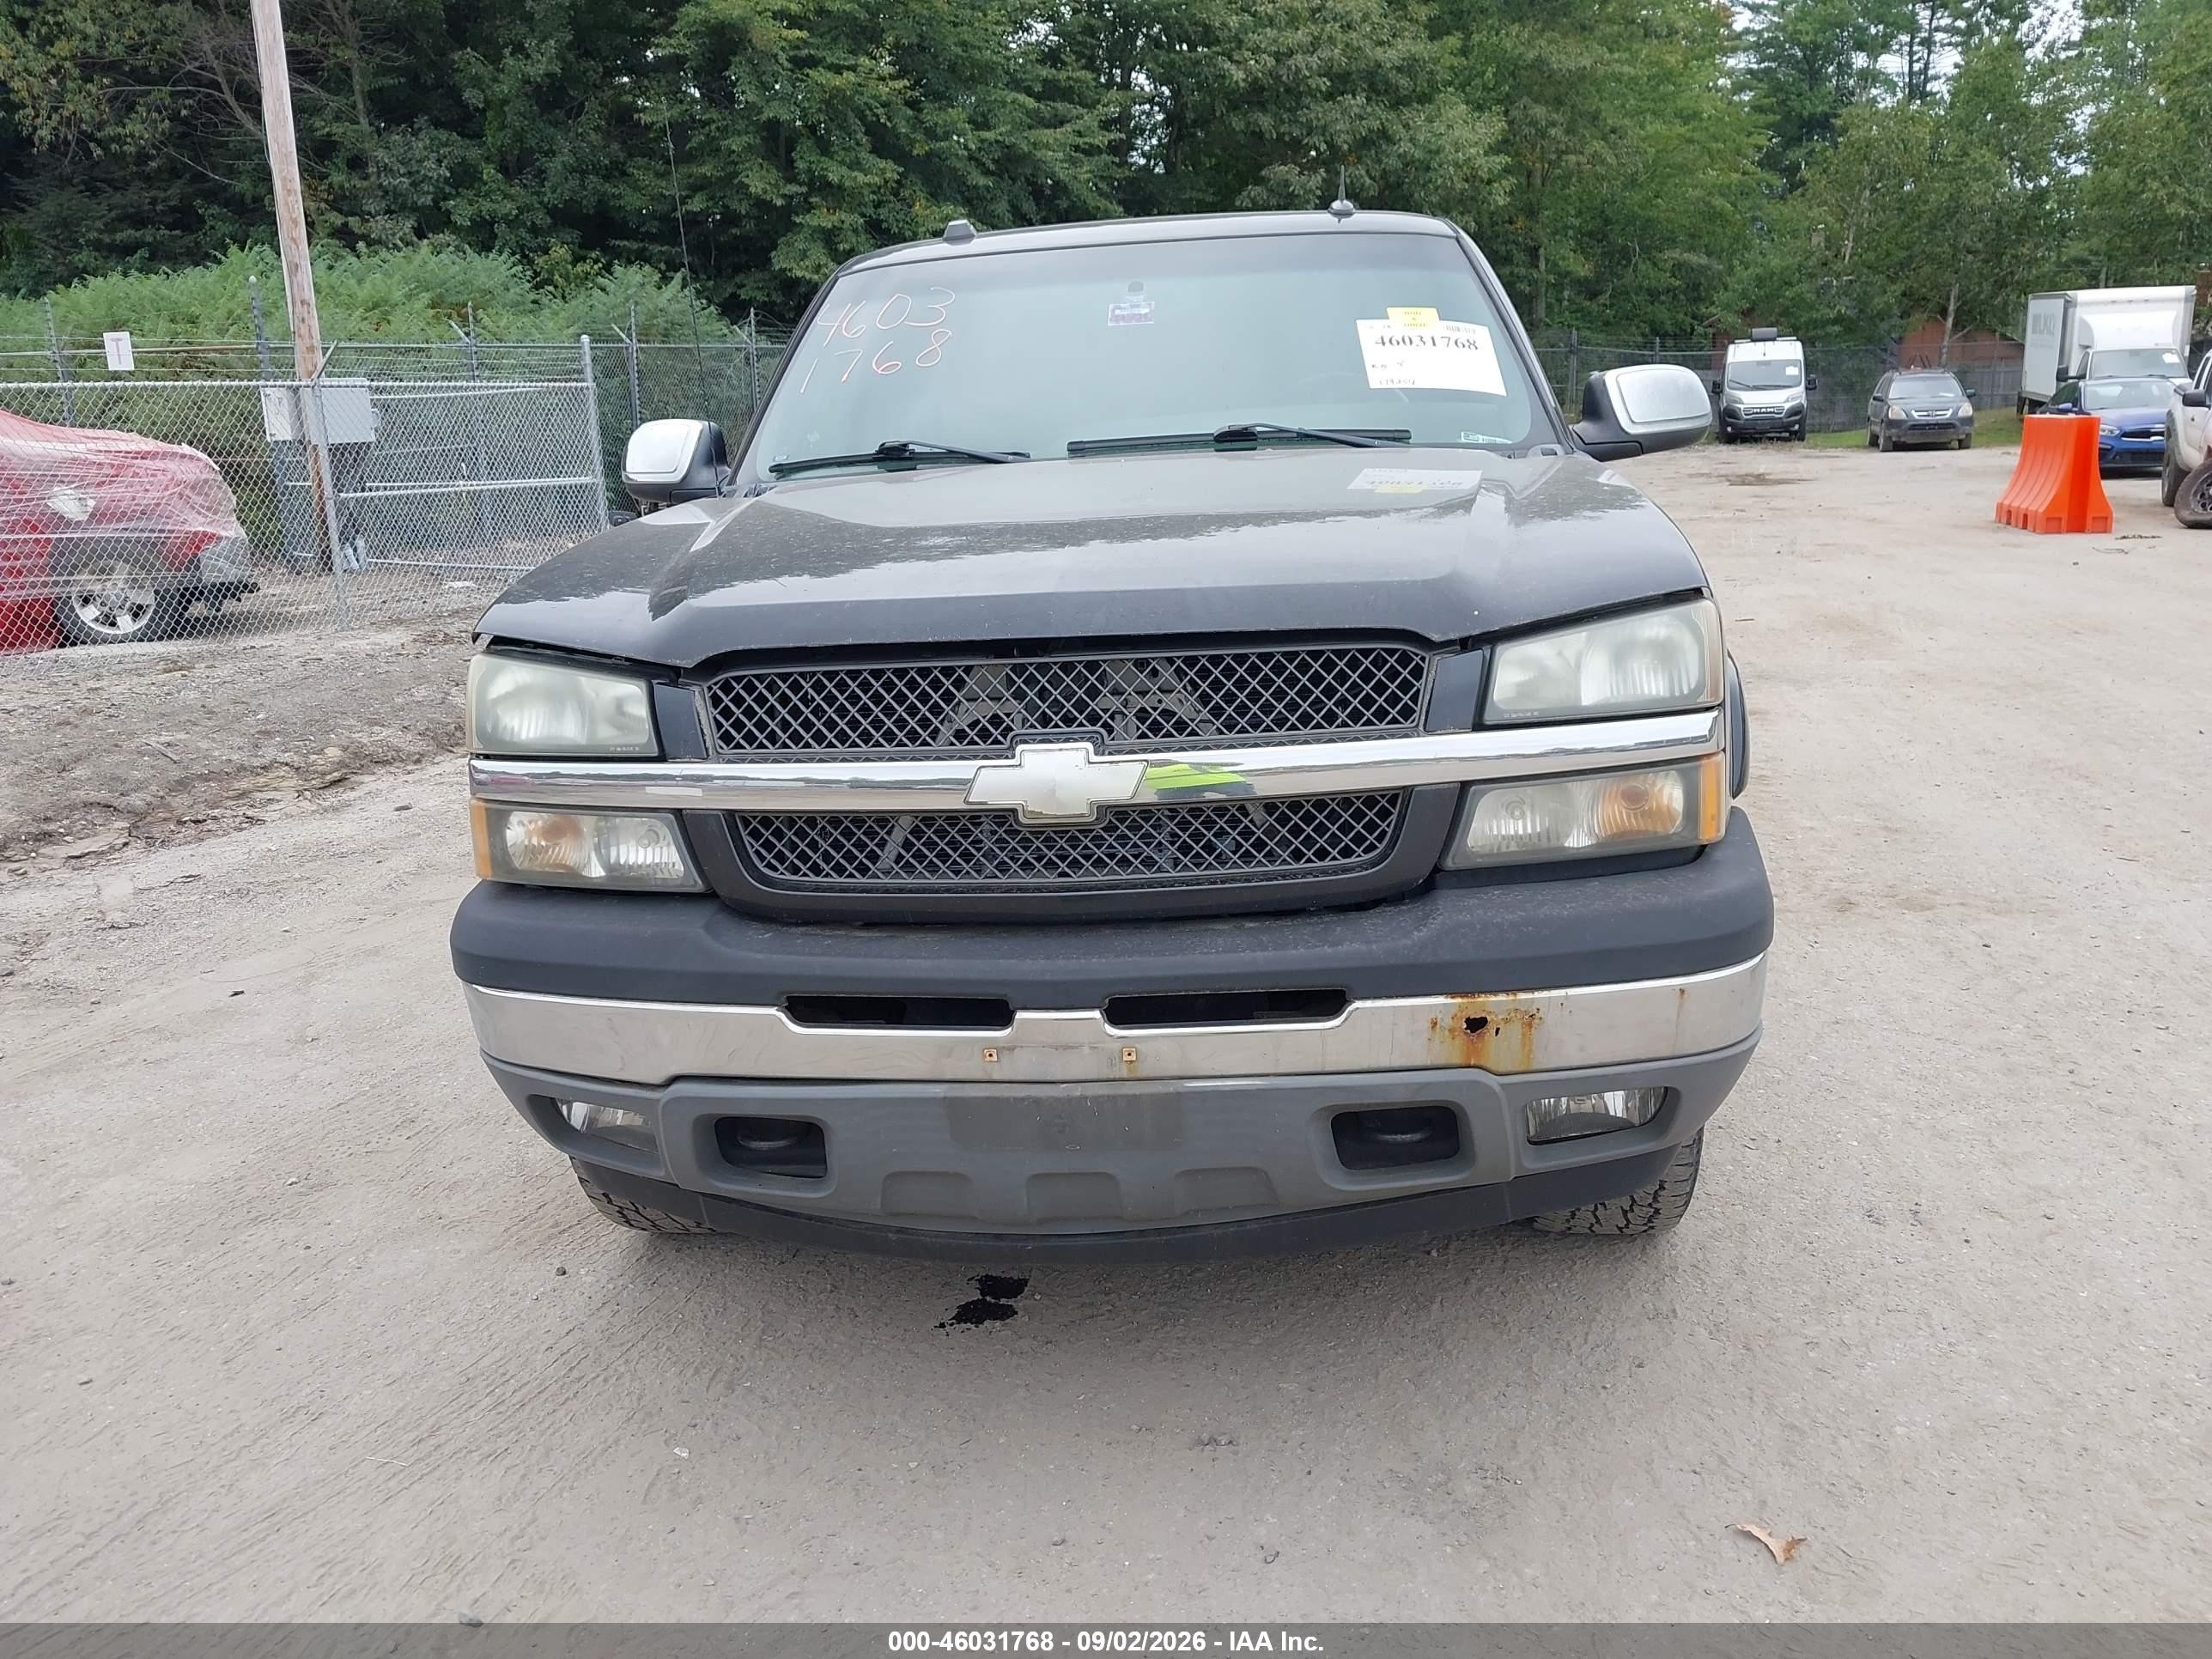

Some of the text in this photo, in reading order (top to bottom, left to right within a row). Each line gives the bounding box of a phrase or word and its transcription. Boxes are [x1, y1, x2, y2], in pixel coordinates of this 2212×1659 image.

[817, 287, 956, 348] 4603
[1375, 335, 1478, 350] 46031768
[799, 329, 952, 394] 1768
